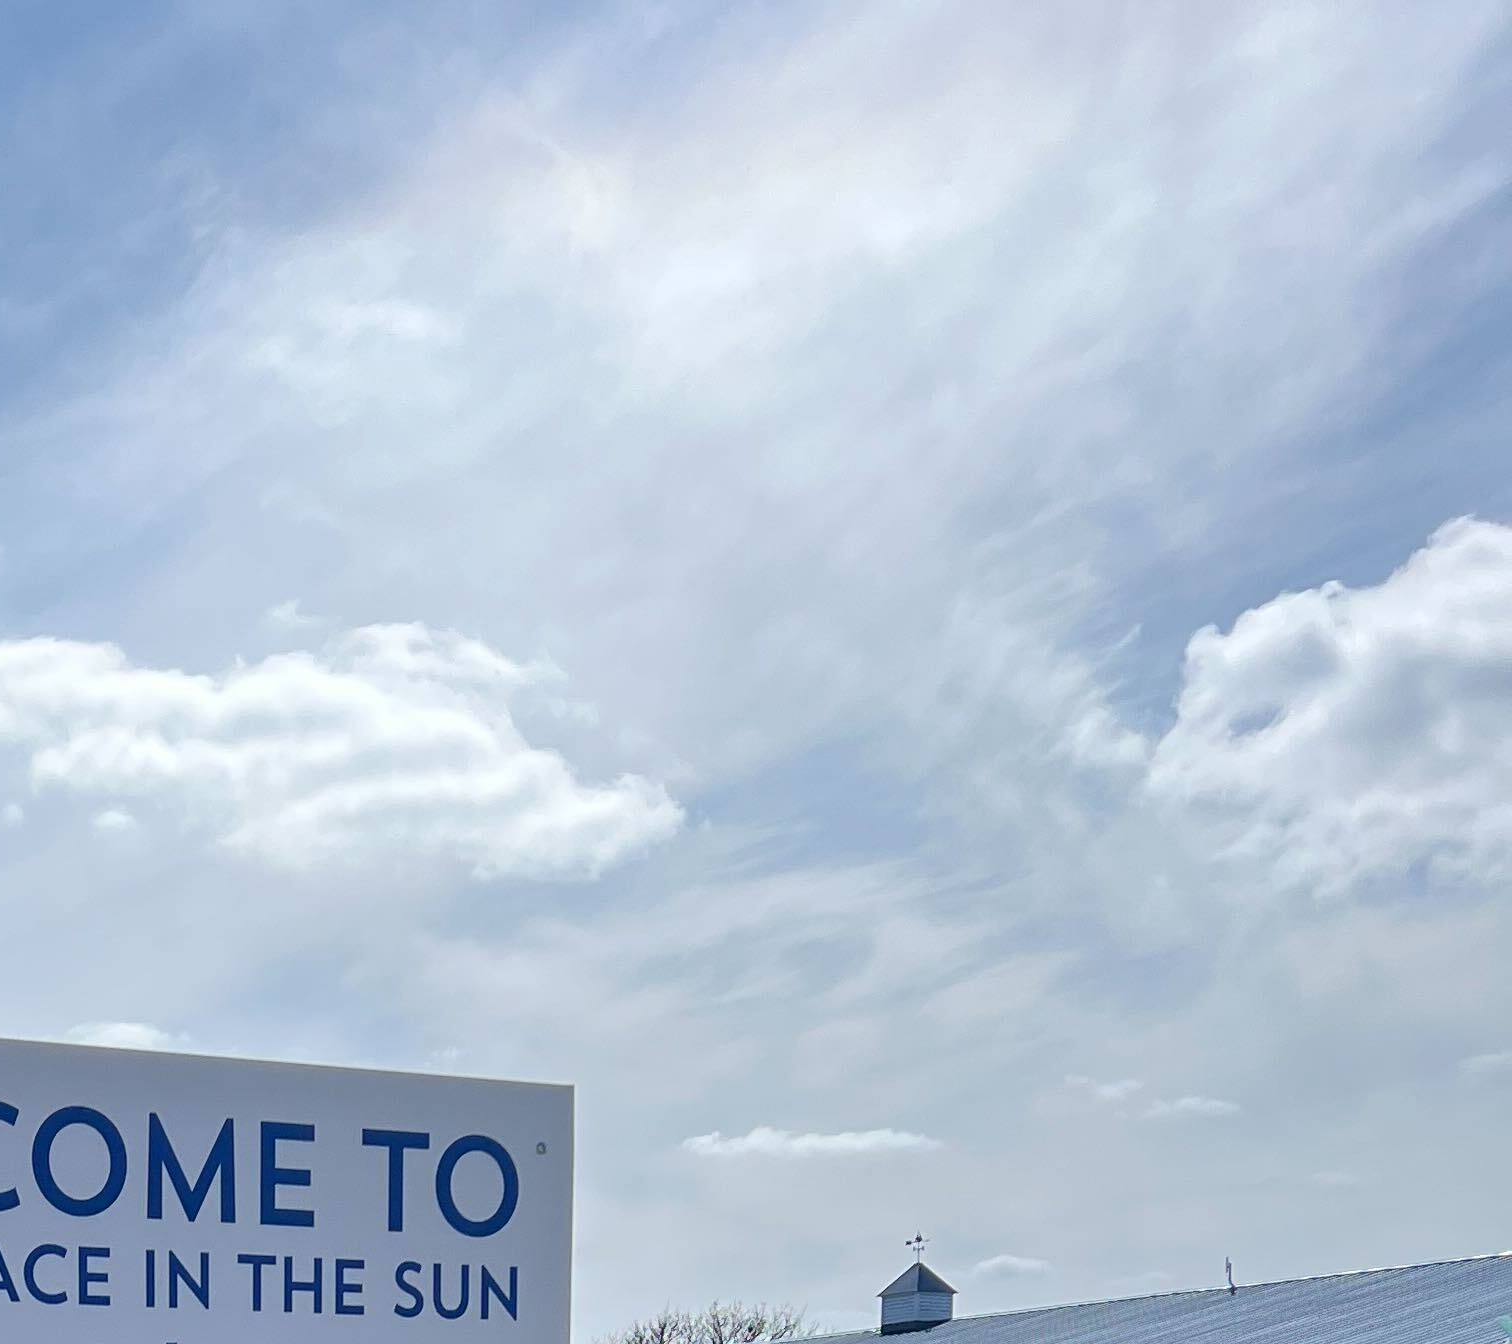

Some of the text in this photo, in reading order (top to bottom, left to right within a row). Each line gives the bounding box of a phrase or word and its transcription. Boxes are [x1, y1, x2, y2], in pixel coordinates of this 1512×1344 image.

[361, 1128, 520, 1239] TO
[144, 1249, 211, 1311] IN
[236, 1252, 366, 1317] THE
[393, 1260, 519, 1321] SUN
